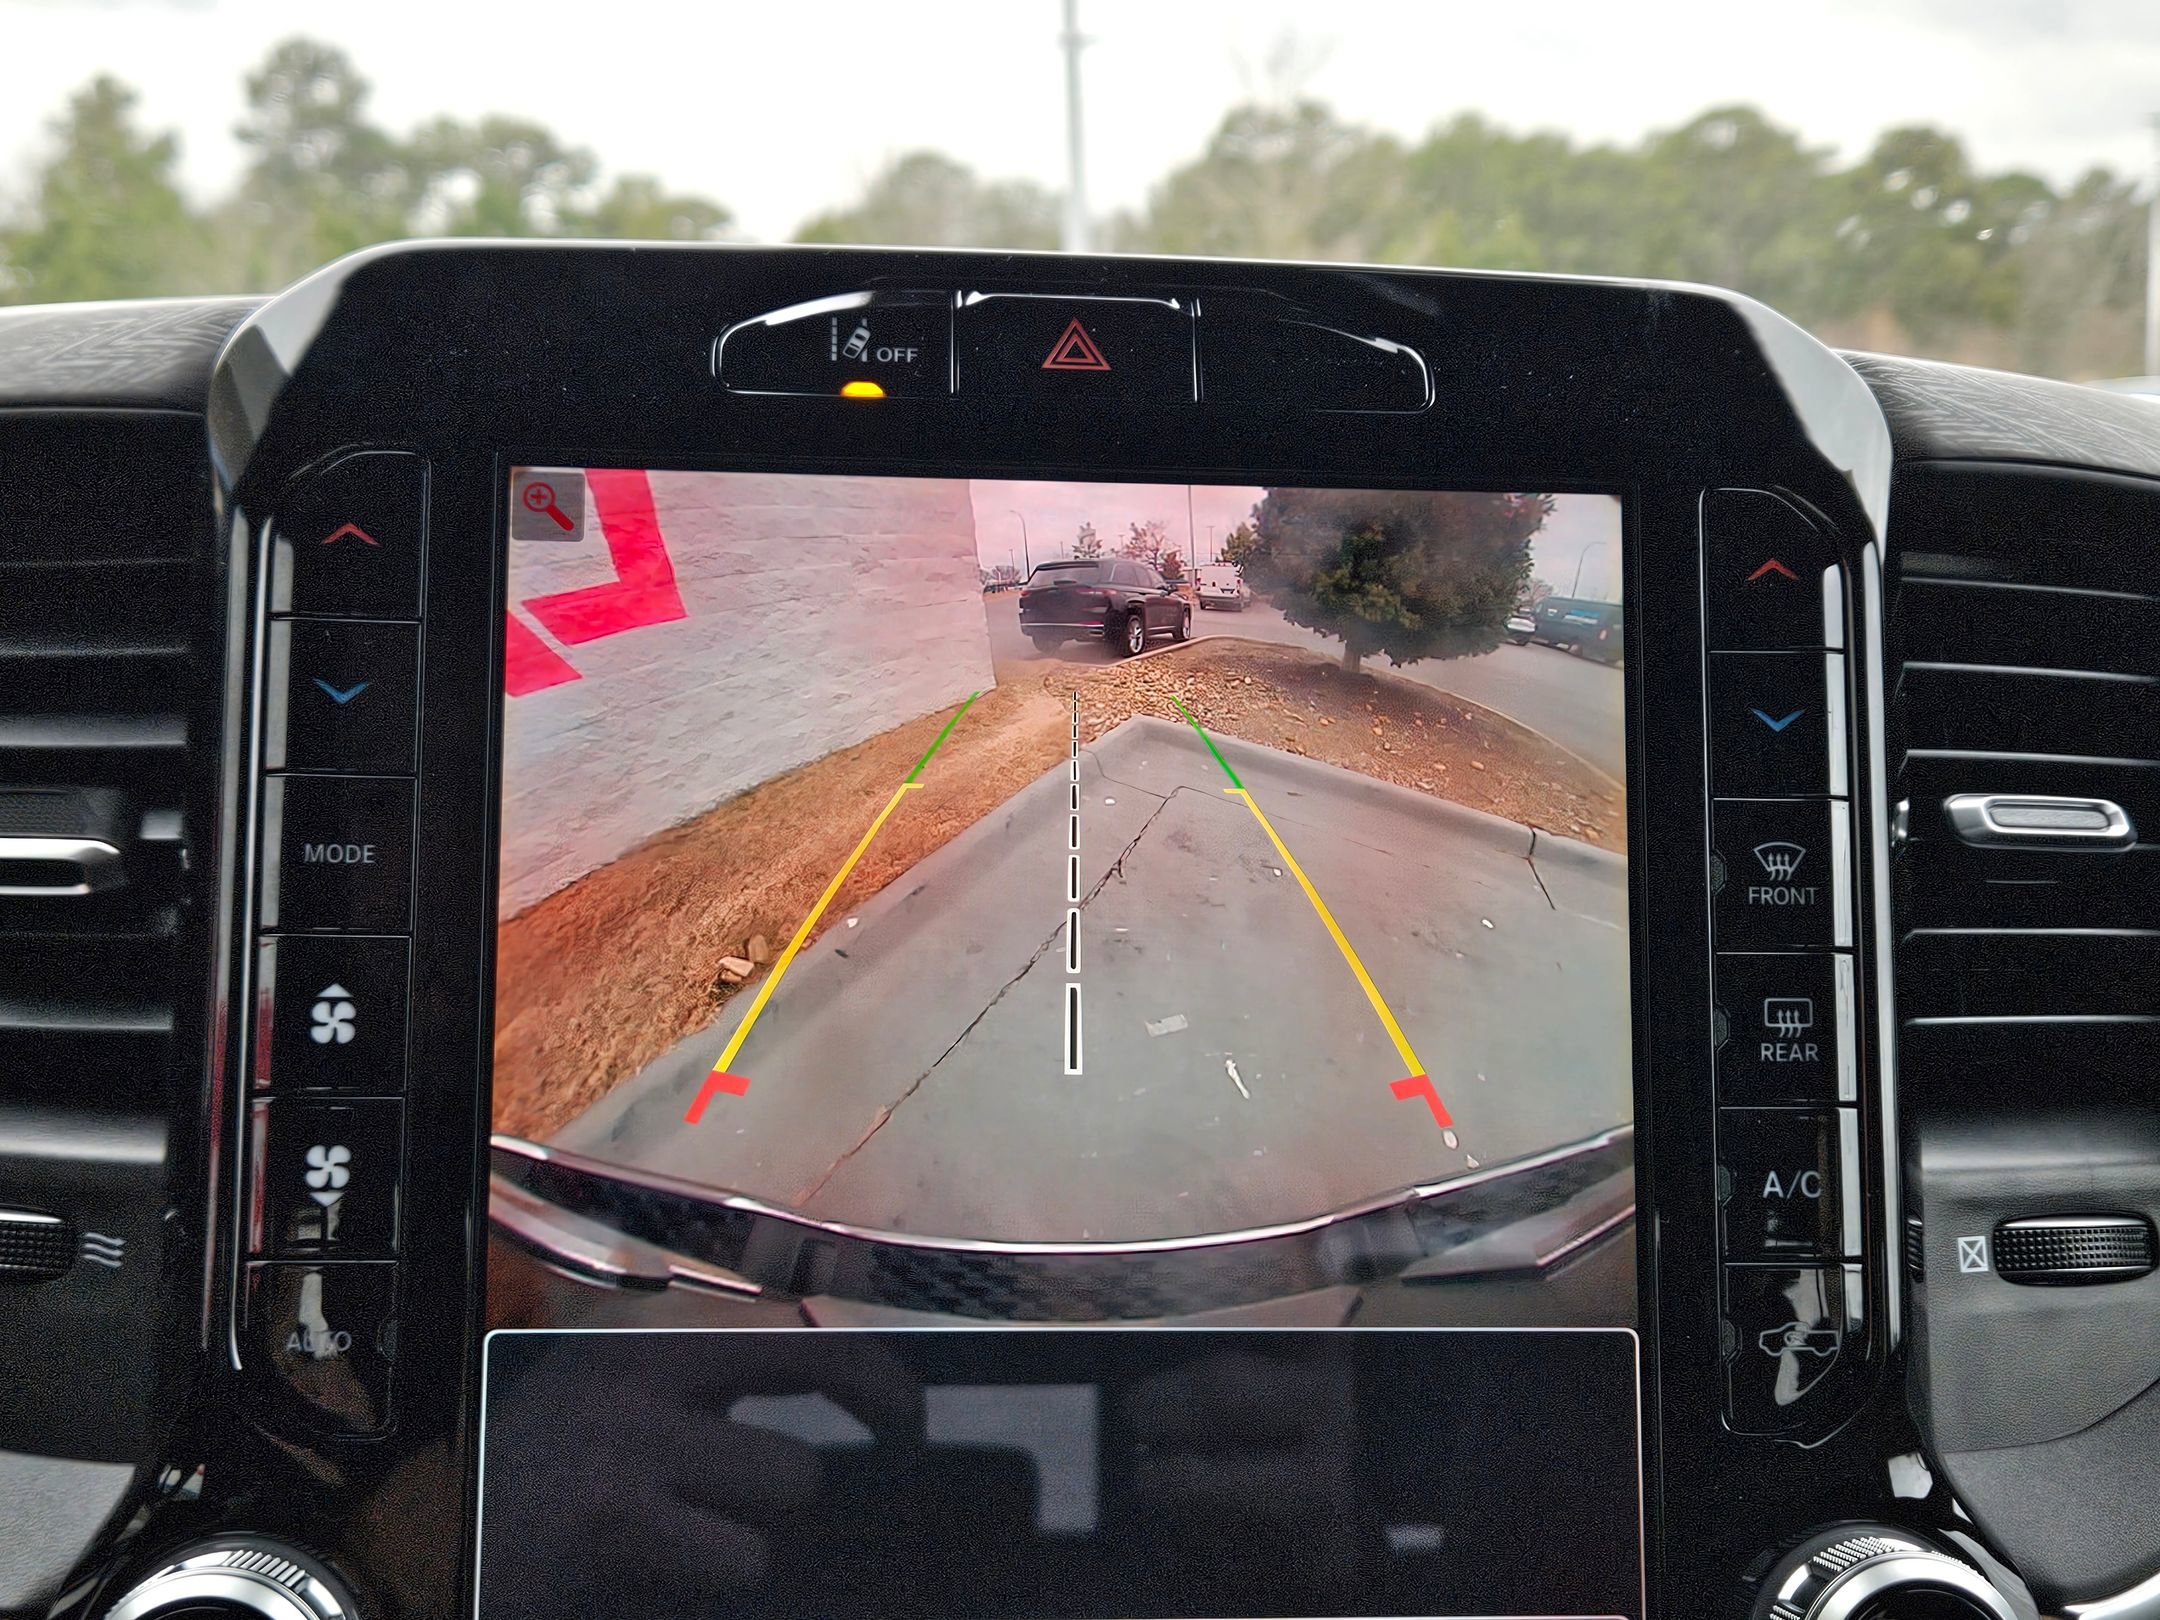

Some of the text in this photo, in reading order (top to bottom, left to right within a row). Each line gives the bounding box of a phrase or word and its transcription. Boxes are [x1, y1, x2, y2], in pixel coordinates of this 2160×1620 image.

[876, 347, 918, 363] OFF
[304, 843, 376, 863] MODE
[1748, 886, 1820, 905] FRONT
[1760, 1042, 1819, 1062] REAR
[1762, 1170, 1821, 1199] A/C
